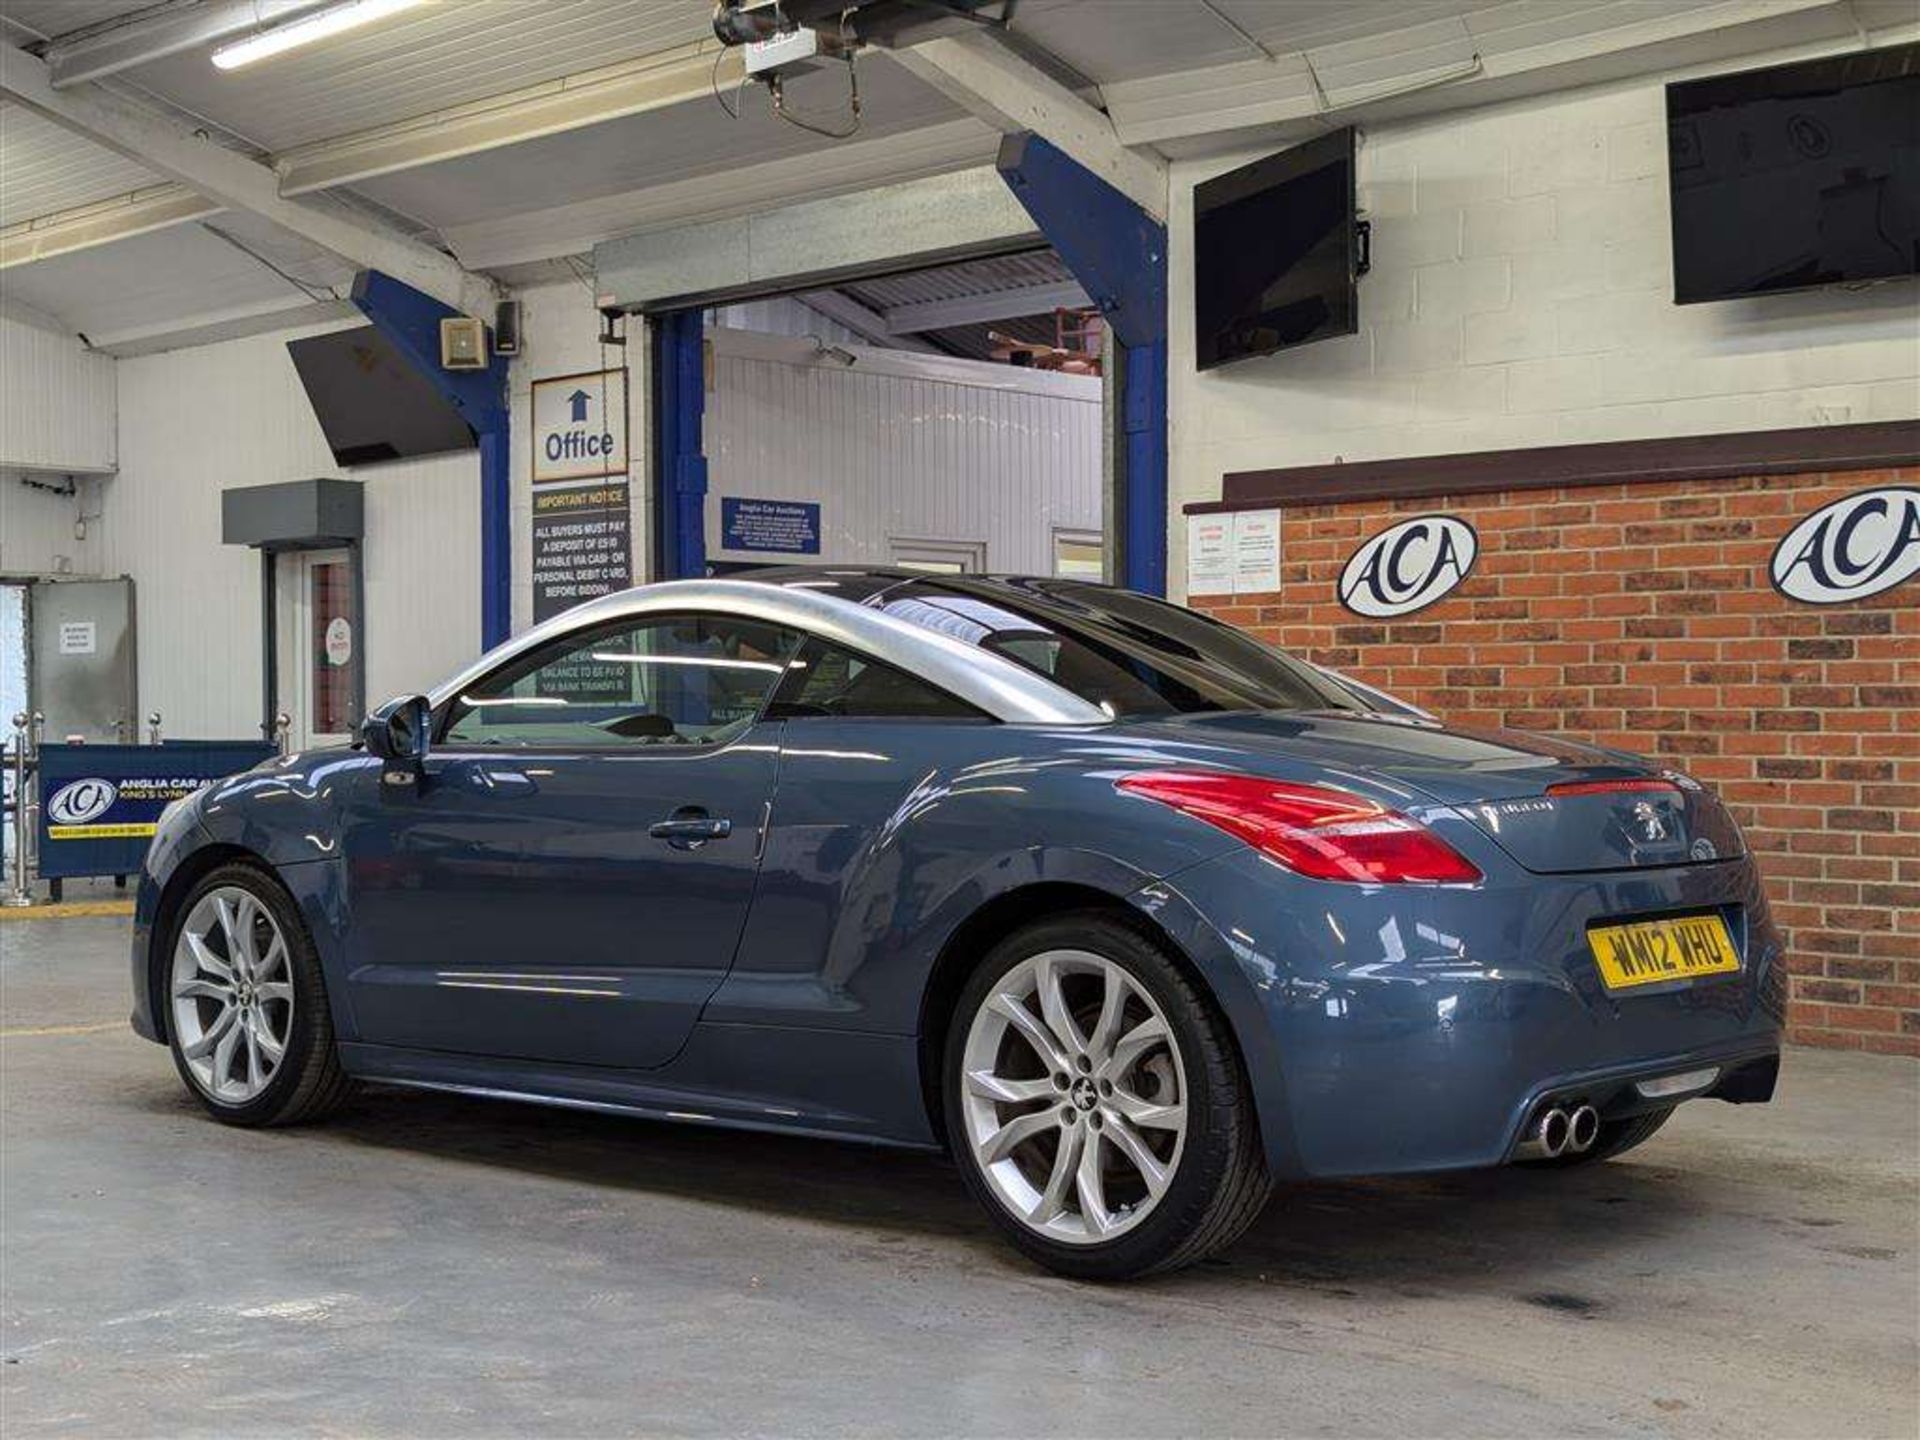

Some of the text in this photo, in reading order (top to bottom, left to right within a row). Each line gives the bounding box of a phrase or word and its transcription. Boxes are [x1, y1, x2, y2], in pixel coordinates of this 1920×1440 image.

[546, 431, 614, 461] Office
[537, 489, 624, 508] IMPORTANT NOTICE
[762, 505, 775, 513] Car
[776, 505, 806, 516] Auctions
[535, 520, 626, 538] ALL BUYERS MUST PAY
[542, 541, 550, 552] A
[550, 539, 584, 551] DEPOSIT
[585, 538, 597, 550] OF
[1779, 497, 1920, 590] ACA
[536, 555, 572, 568] PAYABLE
[573, 554, 587, 566] VIA
[612, 551, 625, 563] OR
[1342, 524, 1467, 605] ACA
[534, 571, 575, 583] PERSONAL
[576, 568, 601, 581] DEBIT
[545, 585, 577, 598] BEFORE
[541, 667, 577, 678] BALANCE
[580, 666, 591, 678] TO
[592, 666, 604, 678] BE
[119, 779, 169, 788] ANGLIA
[171, 779, 196, 788] CAR
[53, 784, 107, 816] ACA
[119, 791, 154, 799] KING'S
[1609, 923, 1723, 976] WM12 WHU
